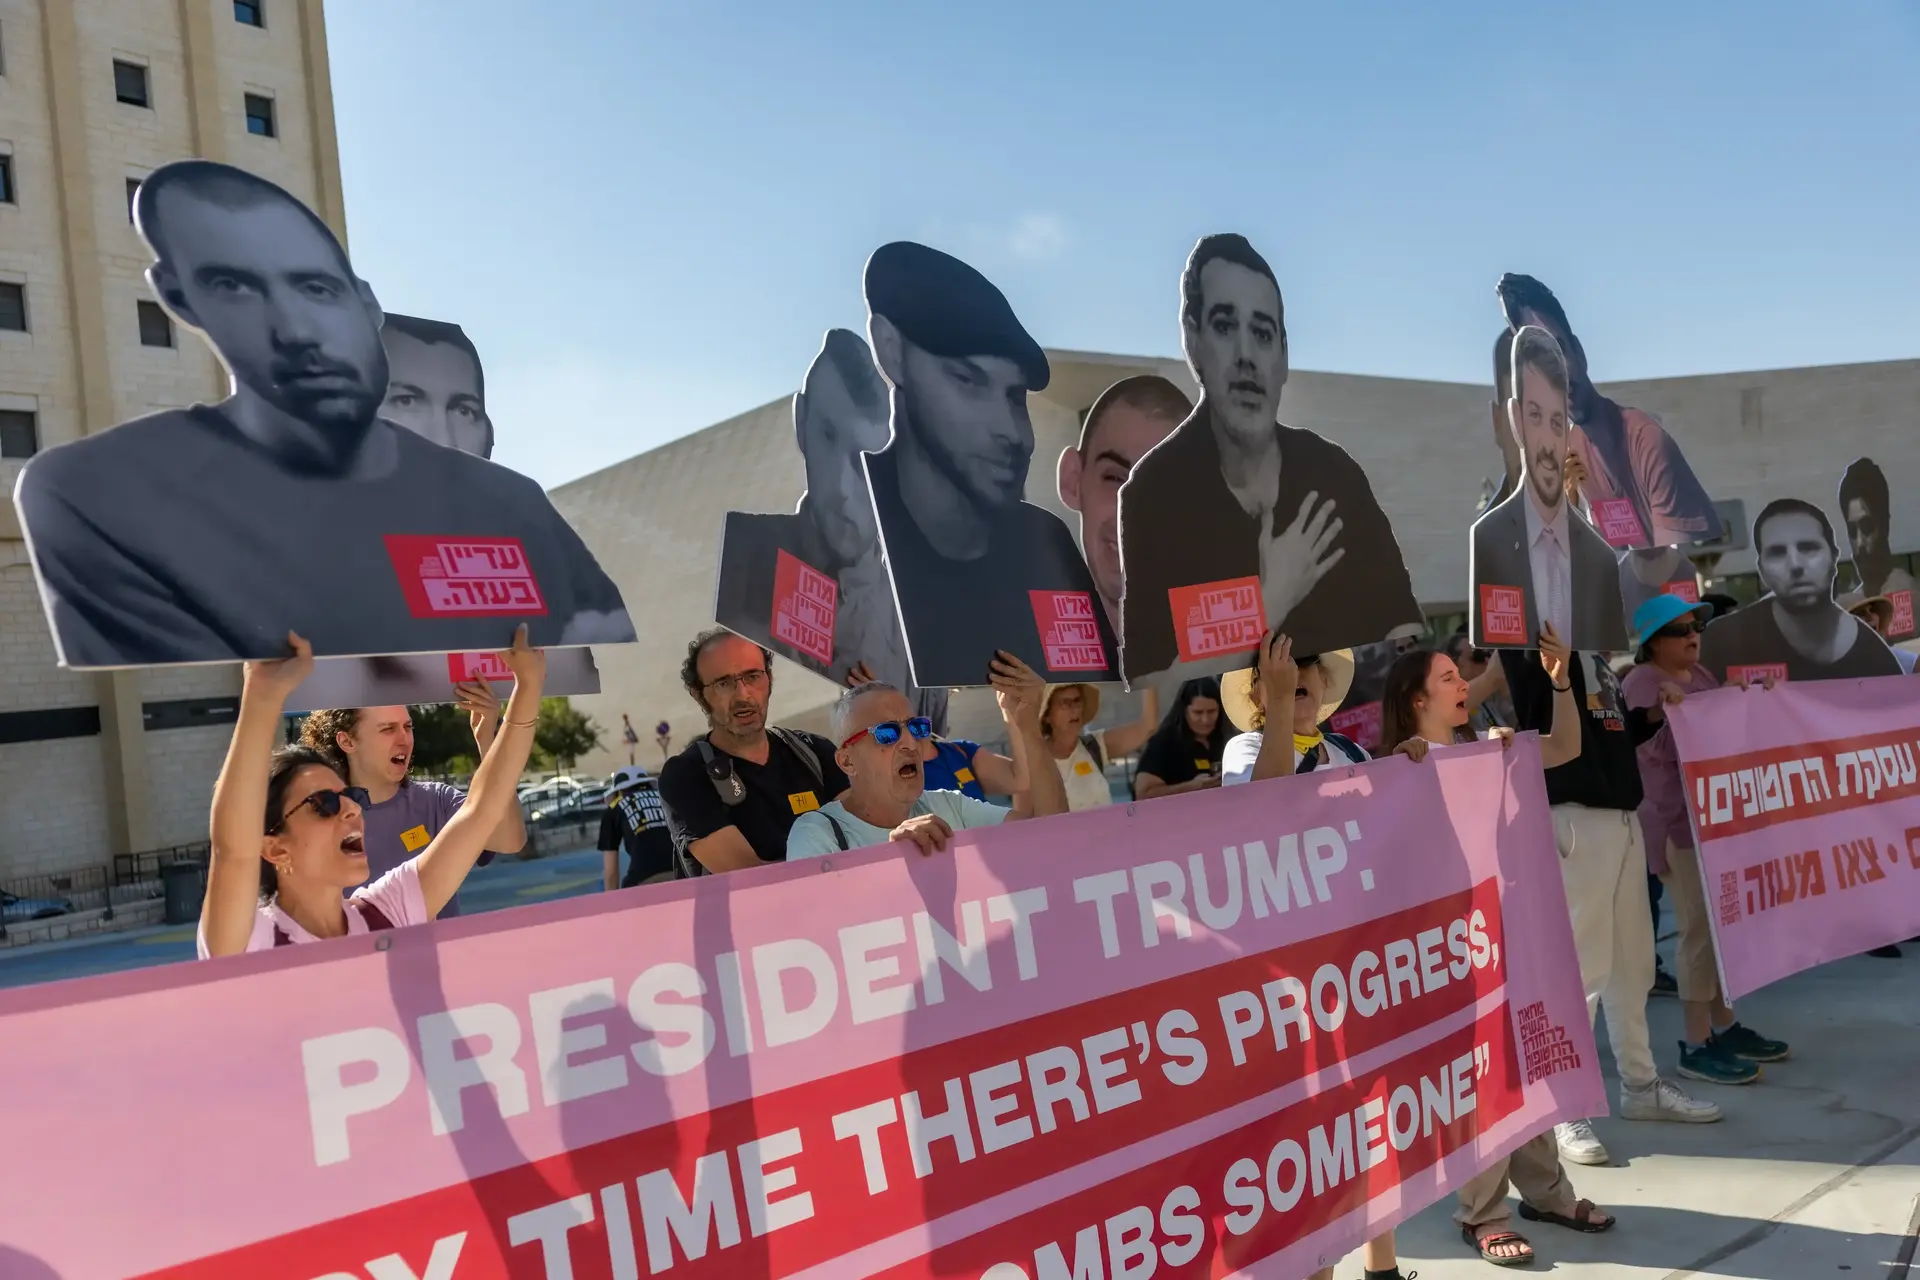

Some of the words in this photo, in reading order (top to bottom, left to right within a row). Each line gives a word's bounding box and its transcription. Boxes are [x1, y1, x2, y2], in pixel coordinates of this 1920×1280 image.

[443, 545, 521, 574] עדיין
[442, 580, 537, 606] בעזה.
[1055, 596, 1092, 617] אלון
[1202, 589, 1254, 620] עדיין
[1494, 590, 1519, 610] עדיין
[794, 593, 833, 629] עדיין
[783, 617, 831, 657] בעזה.
[1056, 622, 1096, 643] עדיין
[1197, 620, 1261, 650] בעזה.
[1056, 647, 1104, 665] בעזה.
[1835, 742, 1917, 800] עסקת
[1696, 756, 1832, 827] החטופים!
[1831, 836, 1886, 890] צאו
[1744, 849, 1827, 916] מעזה
[301, 887, 1048, 1167] PRESIDENT
[1072, 820, 1376, 961] TRUMP:
[1517, 1000, 1545, 1025] מחאת
[1520, 1014, 1549, 1041] הנשים
[507, 1127, 816, 1280] TIME
[832, 1008, 1208, 1196] THERE’S
[1218, 909, 1500, 1068] PROGRESS,
[979, 1185, 1205, 1280] MBS
